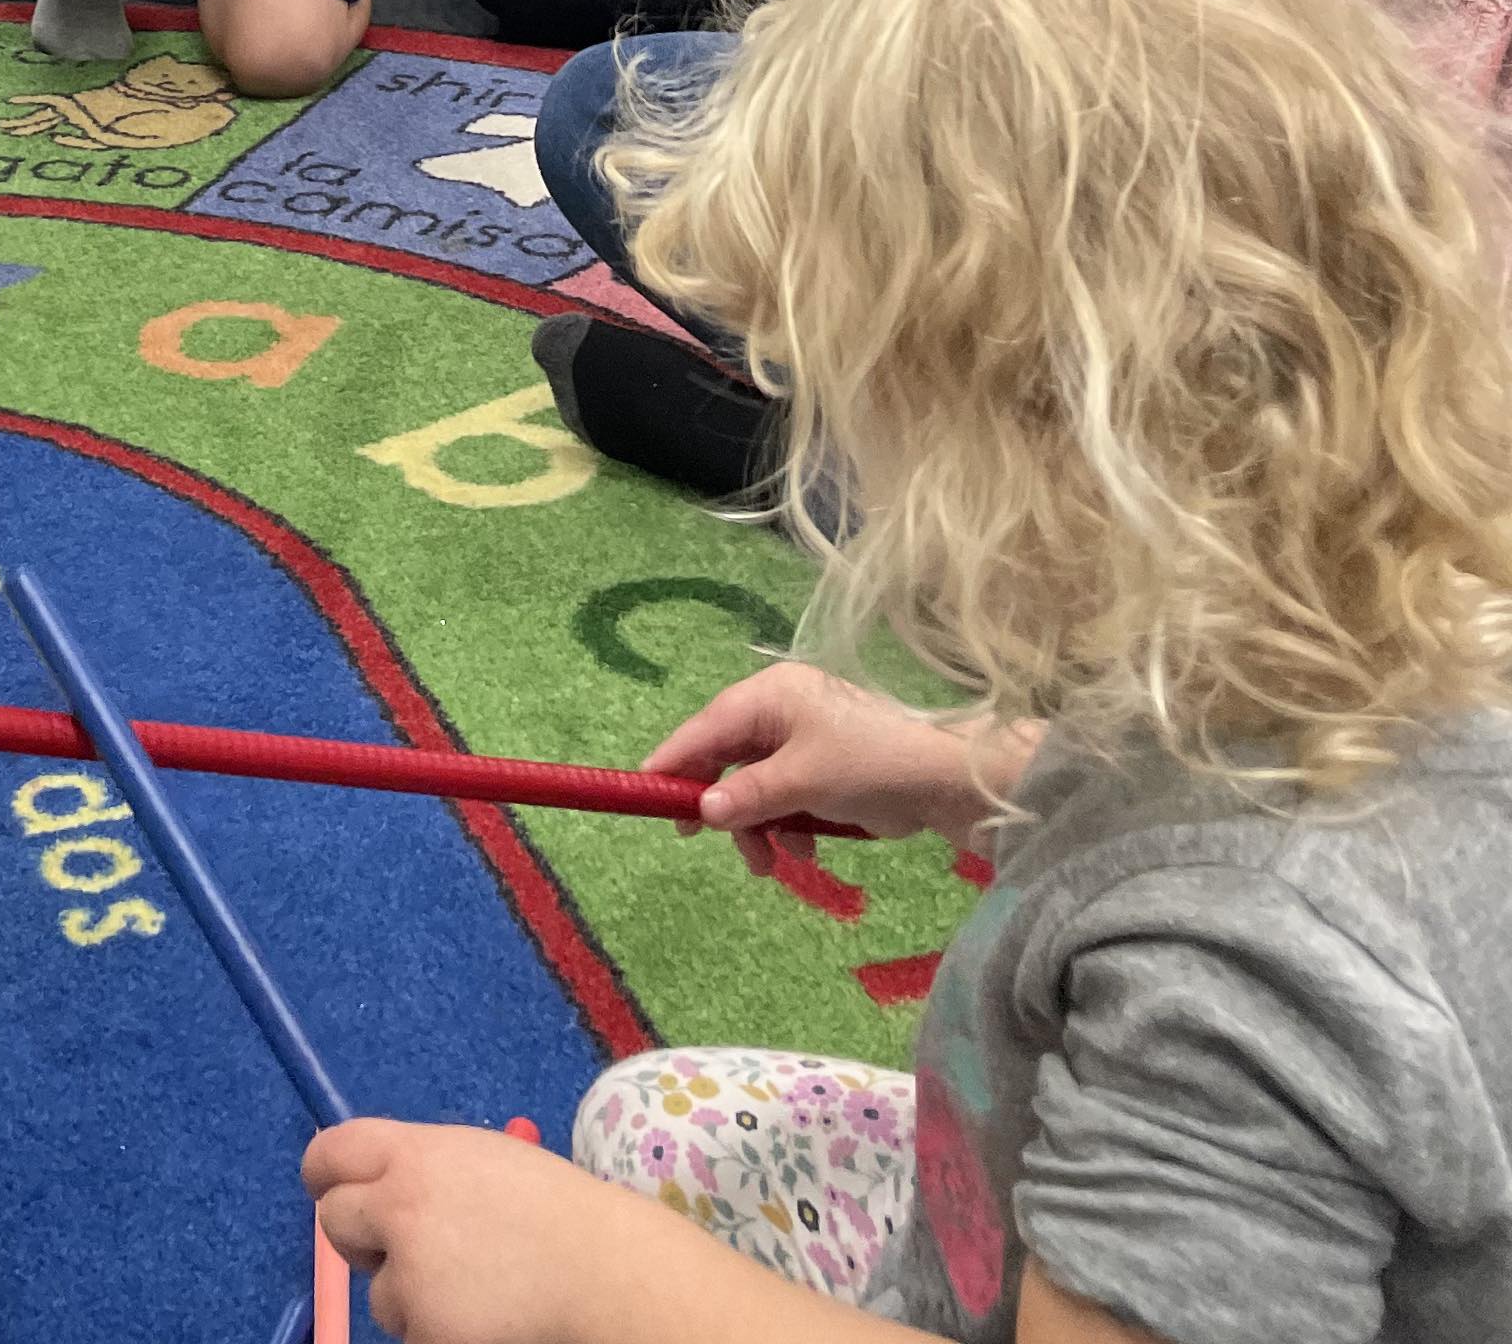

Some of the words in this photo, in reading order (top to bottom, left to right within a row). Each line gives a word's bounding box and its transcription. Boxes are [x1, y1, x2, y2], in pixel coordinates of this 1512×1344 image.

[217, 179, 588, 259] camisa
[281, 150, 361, 186] la
[138, 299, 343, 389] a
[355, 382, 599, 510] b
[12, 772, 166, 947] dos
